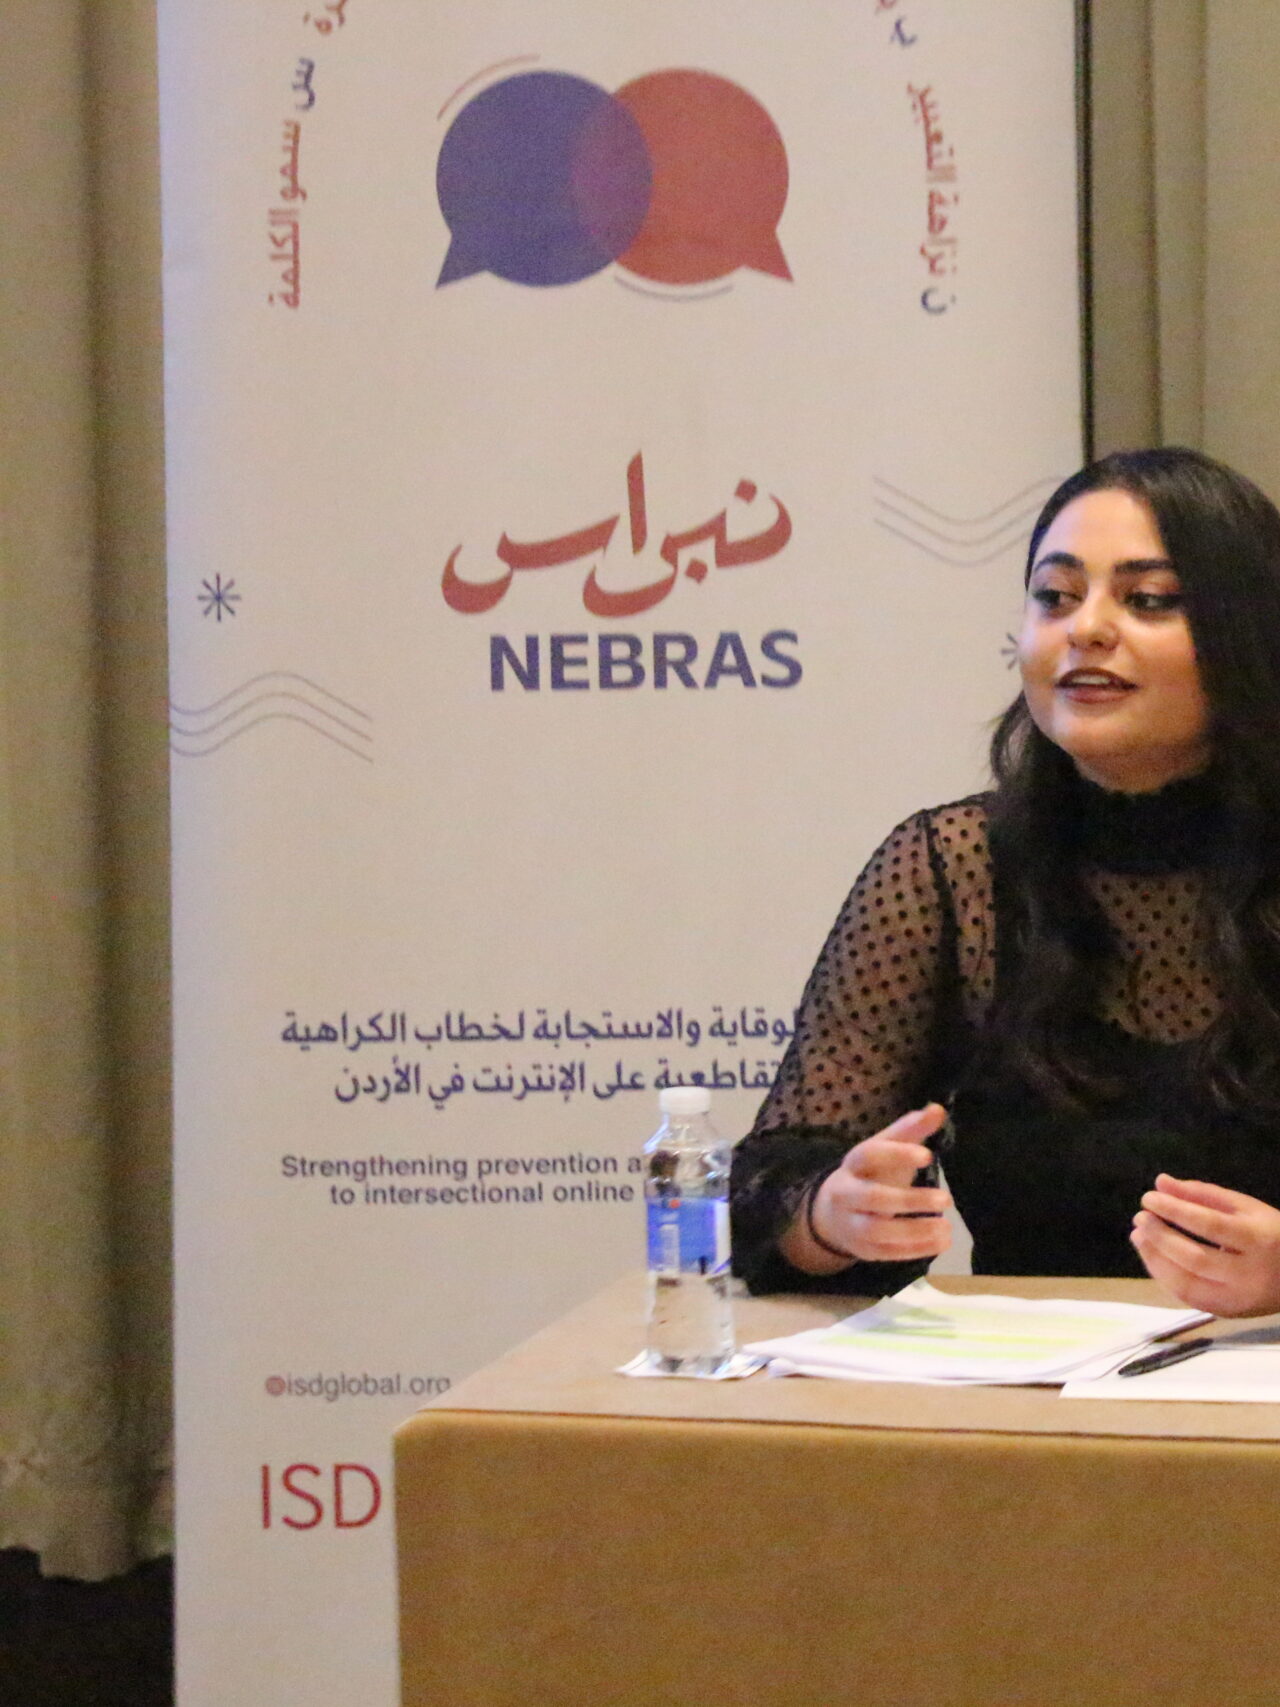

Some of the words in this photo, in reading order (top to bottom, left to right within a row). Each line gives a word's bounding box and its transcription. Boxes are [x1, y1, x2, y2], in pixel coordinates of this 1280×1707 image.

[441, 448, 793, 618] نبراس
[489, 629, 803, 691] NEBRAS
[281, 1010, 406, 1052] الكراهية
[414, 1009, 524, 1051] لخطاب
[532, 1007, 701, 1049] والاستجابة
[335, 1054, 421, 1103] الأردن
[428, 1062, 465, 1111] في
[472, 1060, 585, 1102] الإنترنت
[593, 1058, 645, 1100] على
[281, 1155, 468, 1181] Strengthening
[477, 1153, 618, 1179] prevention
[330, 1184, 355, 1205] to
[363, 1182, 543, 1204] intersectional
[552, 1181, 634, 1203] online
[261, 1463, 381, 1530] ISD
